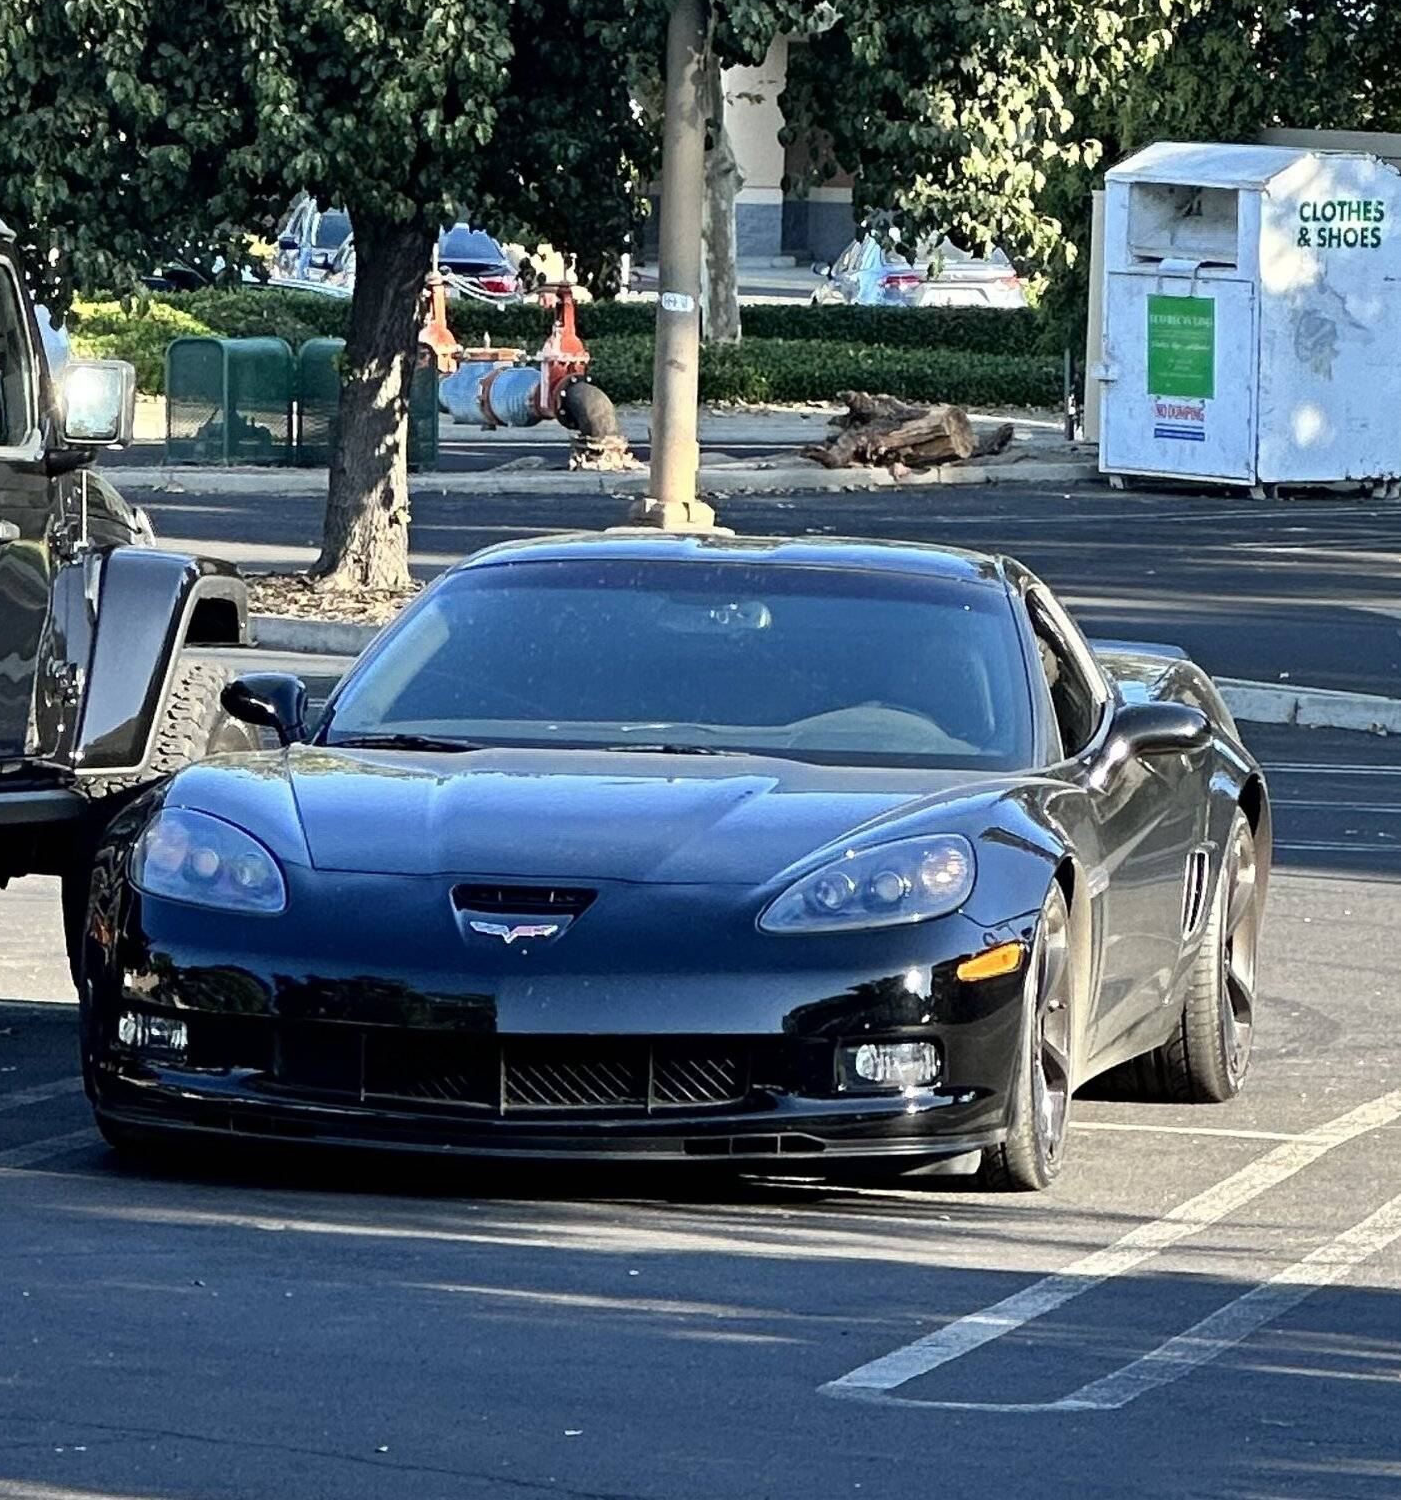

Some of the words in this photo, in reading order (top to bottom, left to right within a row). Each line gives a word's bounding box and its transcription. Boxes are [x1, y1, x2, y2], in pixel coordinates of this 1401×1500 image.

[1299, 200, 1385, 222] CLOTHES
[1297, 226, 1311, 247] &
[1317, 226, 1381, 248] SHOES
